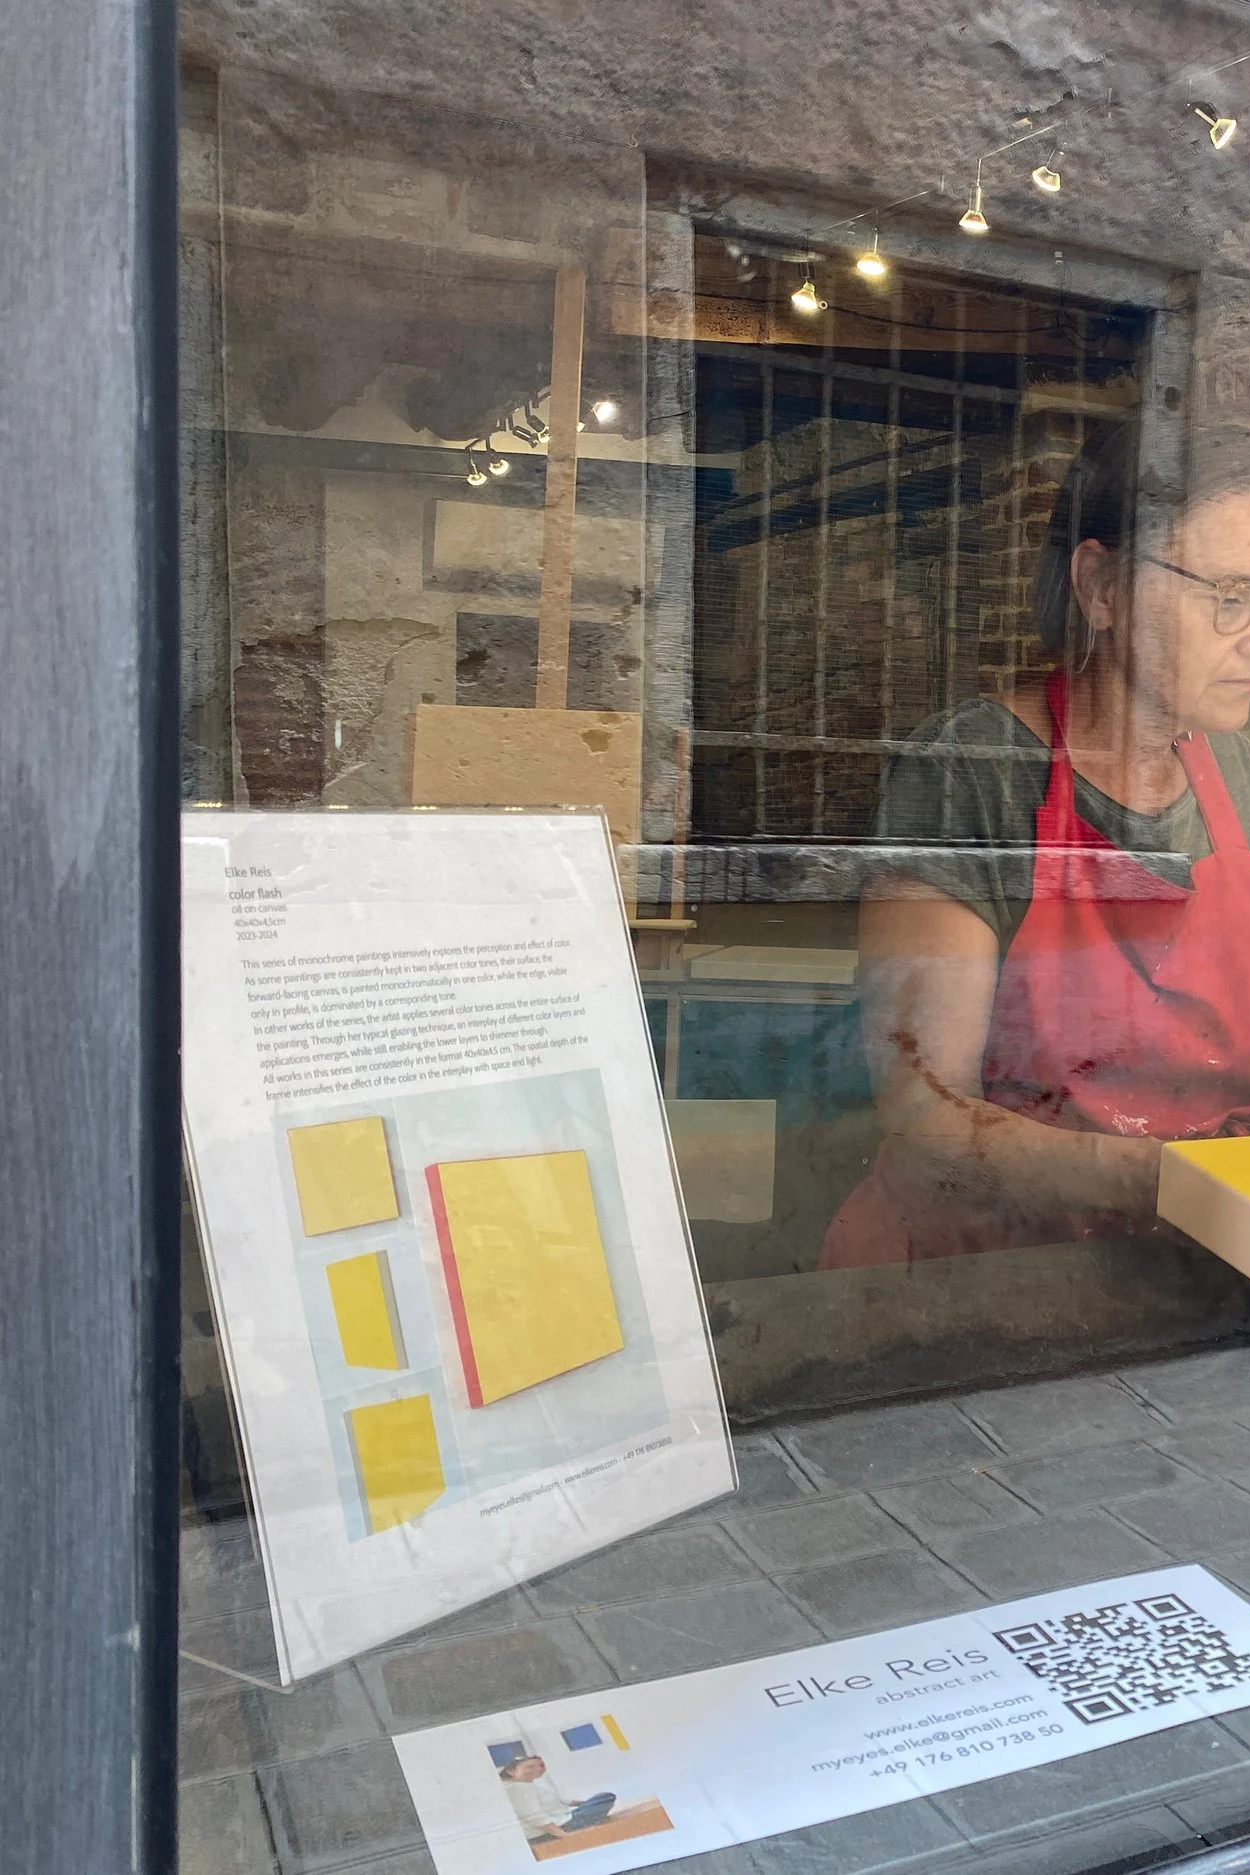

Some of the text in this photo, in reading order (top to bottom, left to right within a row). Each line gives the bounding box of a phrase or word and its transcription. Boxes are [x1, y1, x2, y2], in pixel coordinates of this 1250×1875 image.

[225, 866, 272, 878] Elke Reis
[229, 887, 282, 900] color flash
[231, 904, 242, 913] oil
[258, 904, 288, 912] canvas
[236, 930, 278, 940] 2023-2024
[241, 960, 260, 970] This
[262, 959, 286, 968] series
[288, 957, 296, 966] of
[298, 955, 354, 965] monochrome
[356, 951, 390, 964] paintings
[392, 948, 430, 959] intensively
[432, 946, 462, 958] explores
[463, 945, 474, 954] the
[477, 942, 512, 955] perception
[514, 941, 526, 950] and
[528, 939, 544, 949] effect
[546, 938, 552, 948] of
[245, 976, 255, 985] As
[258, 976, 281, 984] some
[284, 972, 321, 985] paintings
[324, 971, 336, 979] are
[338, 966, 383, 978] consistently
[385, 964, 402, 976] kept
[404, 965, 411, 973] in
[413, 963, 427, 972] two
[428, 960, 458, 973] adjacent
[460, 959, 476, 969] color
[500, 957, 515, 966] their
[542, 954, 552, 963] the
[248, 990, 309, 1003] forward-facing
[310, 988, 340, 997] canvas,
[342, 986, 348, 994] is
[350, 982, 379, 996] painted
[381, 976, 452, 990] monochromatically
[453, 976, 460, 984] in
[462, 976, 475, 984] one
[477, 973, 496, 982] color,
[496, 971, 515, 981] while
[516, 970, 528, 979] the
[250, 1009, 269, 1020] only
[272, 1008, 280, 1017] in
[282, 1005, 310, 1018] profile,
[312, 1005, 318, 1013] is
[320, 999, 364, 1012] dominated
[366, 999, 376, 1010] by
[378, 999, 383, 1007] a
[384, 994, 438, 1006] corresponding
[254, 1026, 262, 1035] In
[264, 1024, 287, 1034] other
[290, 1021, 314, 1031] works
[316, 1019, 324, 1028] of
[326, 1018, 340, 1027] the
[367, 1014, 380, 1023] the
[382, 1011, 400, 1021] artist
[402, 1009, 428, 1021] applies
[430, 1005, 454, 1017] several
[456, 1004, 473, 1014] color
[475, 1003, 494, 1012] tones
[496, 1001, 516, 1010] across
[517, 998, 528, 1008] the
[530, 997, 548, 1006] entire
[550, 995, 572, 1004] surface
[574, 993, 580, 1002] of
[256, 1042, 270, 1052] the
[310, 1033, 346, 1046] Through
[348, 1033, 360, 1042] her
[363, 1029, 388, 1042] typical
[390, 1027, 418, 1040] glazing
[458, 1022, 466, 1030] an
[468, 1018, 496, 1029] interplay
[499, 1016, 505, 1025] of
[507, 1012, 534, 1024] different
[536, 1011, 551, 1021] color
[553, 1010, 571, 1021] layers
[574, 1007, 585, 1017] and
[260, 1055, 310, 1070] applications
[350, 1046, 371, 1056] while
[374, 1043, 387, 1054] still
[389, 1041, 422, 1052] enabling
[423, 1038, 435, 1048] the
[436, 1037, 457, 1046] lower
[459, 1035, 479, 1045] layers
[480, 1032, 487, 1041] to
[489, 1030, 518, 1040] shimmer
[264, 1074, 274, 1084] All
[276, 1072, 302, 1082] works
[304, 1071, 312, 1079] in
[314, 1068, 328, 1078] this
[330, 1066, 352, 1076] series
[355, 1064, 367, 1072] are
[369, 1057, 414, 1071] consistently
[416, 1056, 423, 1065] in
[425, 1054, 437, 1063] the
[438, 1050, 462, 1062] format
[513, 1043, 526, 1052] The
[528, 1039, 548, 1052] spatial
[550, 1037, 568, 1049] depth
[570, 1035, 576, 1045] of
[578, 1035, 588, 1044] the
[266, 1090, 290, 1101] frame
[293, 1084, 334, 1096] intensifies
[335, 1081, 349, 1090] the
[350, 1077, 372, 1088] effect
[374, 1075, 381, 1085] of
[383, 1074, 396, 1084] the
[398, 1071, 416, 1082] color
[419, 1071, 426, 1079] in
[428, 1068, 440, 1078] the
[442, 1064, 472, 1076] interplay
[474, 1061, 489, 1071] with
[491, 1060, 510, 1071] space
[512, 1056, 524, 1066] and
[764, 1649, 988, 1707] Elke Reis
[876, 1670, 1000, 1705] abstract art
[864, 1694, 1033, 1740] www.elkereis.com
[811, 1708, 1048, 1772] myeyes.elke@gmail.com
[870, 1724, 1063, 1778] +49 176 810 738 50
